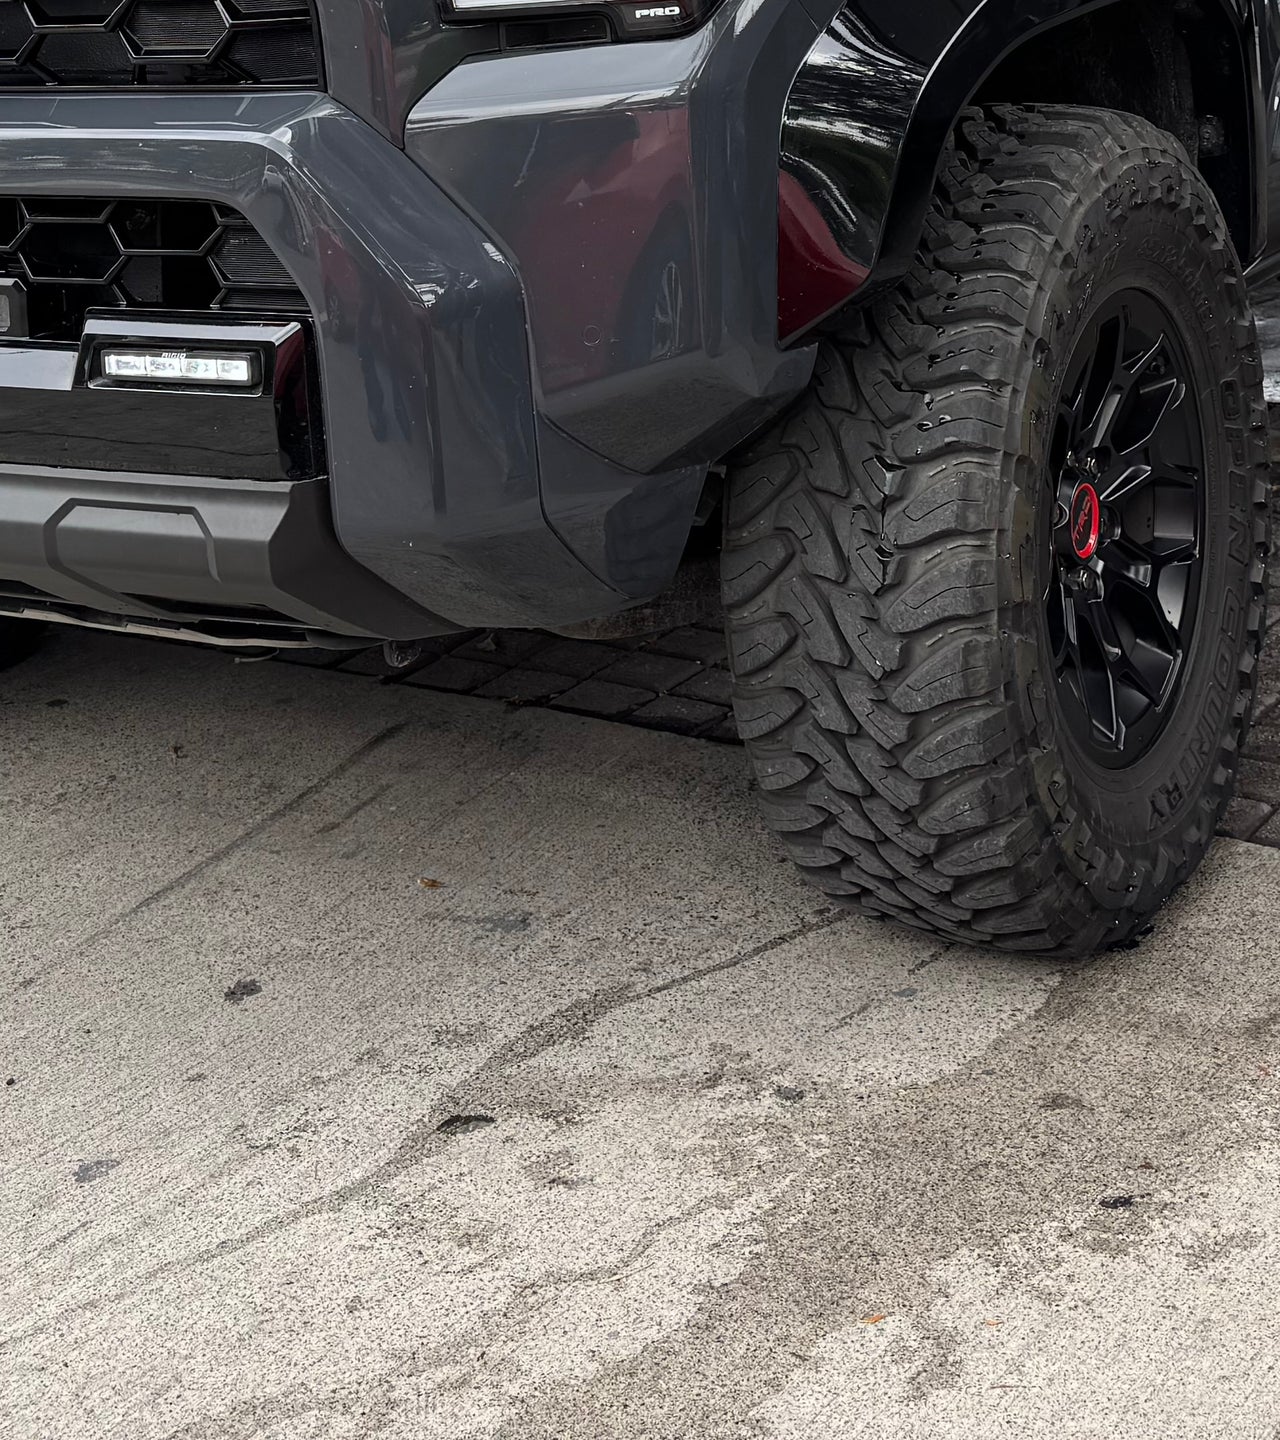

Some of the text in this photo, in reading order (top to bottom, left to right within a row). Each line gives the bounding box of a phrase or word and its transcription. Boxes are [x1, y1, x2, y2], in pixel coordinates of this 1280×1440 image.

[634, 6, 680, 19] PRO
[1148, 377, 1250, 832] OPEN COUNTRY
